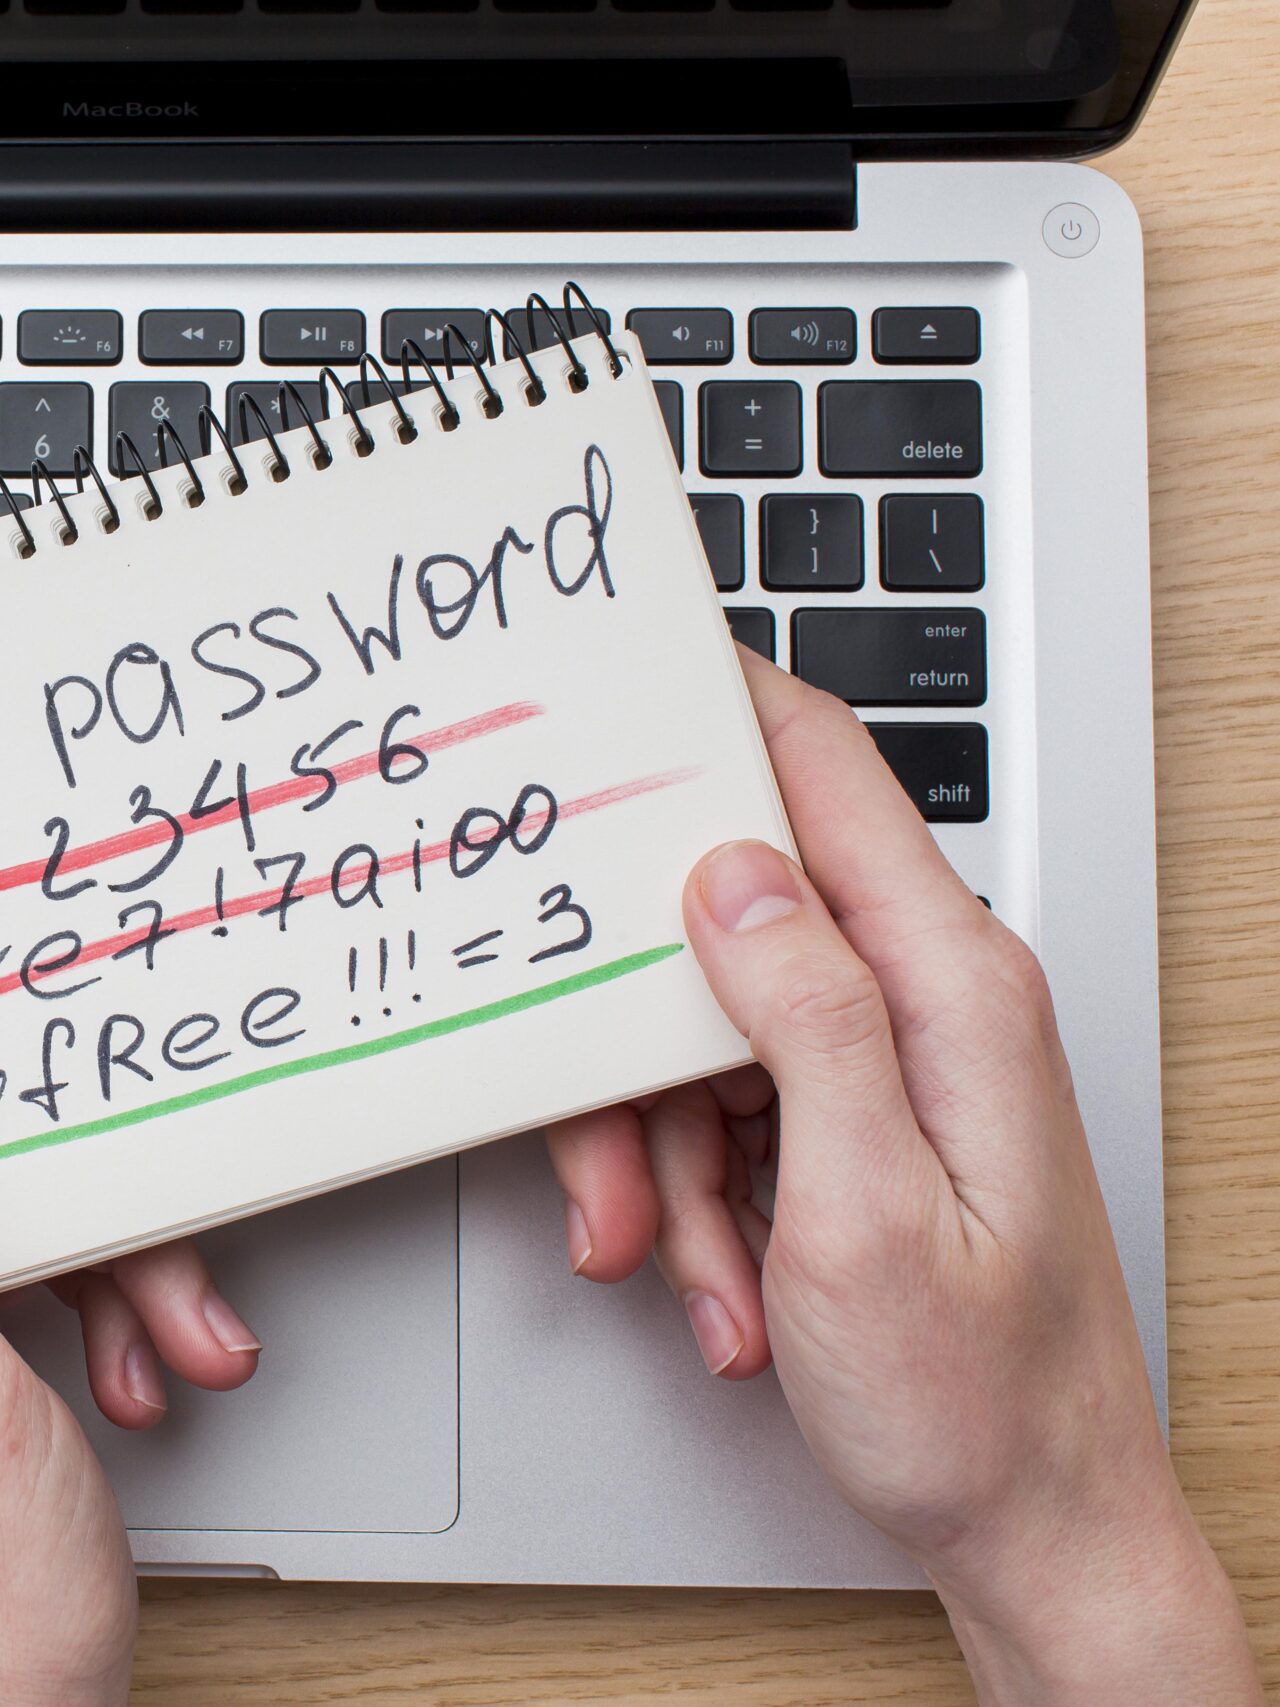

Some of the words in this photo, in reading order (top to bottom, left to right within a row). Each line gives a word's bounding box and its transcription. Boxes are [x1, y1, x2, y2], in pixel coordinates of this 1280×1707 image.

[62, 101, 199, 117] MacBook
[96, 340, 111, 352] F6
[218, 339, 234, 351] F7
[340, 340, 355, 352] F8
[705, 339, 724, 351] F11
[826, 339, 847, 352] F12
[150, 395, 170, 420] &
[744, 399, 762, 417] +
[34, 434, 51, 460] 6
[744, 438, 763, 450] =
[902, 440, 963, 459] delete
[809, 508, 820, 535] }
[811, 547, 818, 573] ]
[929, 549, 943, 573] \
[925, 624, 967, 638] enter
[910, 669, 969, 686] return
[928, 783, 971, 802] shift
